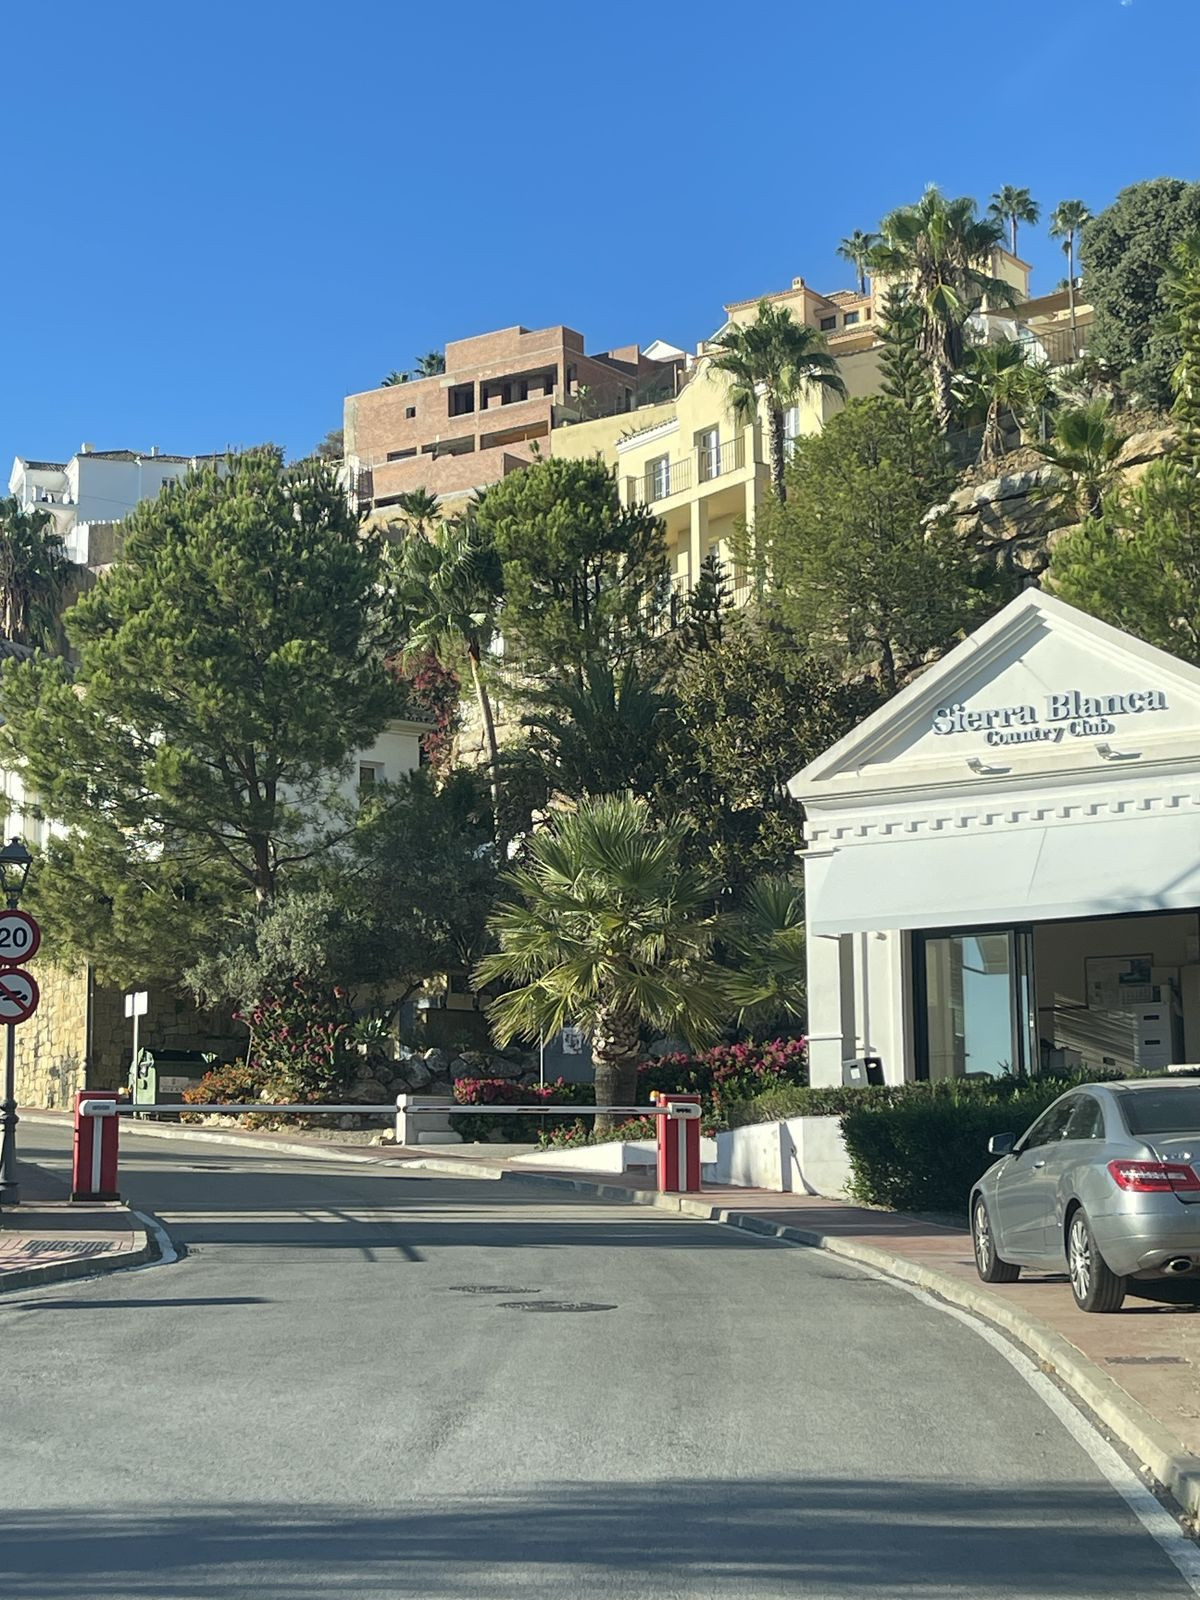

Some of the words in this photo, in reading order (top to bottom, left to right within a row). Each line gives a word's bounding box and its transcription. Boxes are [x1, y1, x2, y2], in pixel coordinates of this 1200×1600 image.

[932, 704, 1038, 734] Sierra
[1044, 690, 1168, 721] Blanca
[985, 727, 1064, 746] Country
[1067, 718, 1115, 737] Club
[0, 927, 27, 947] 20
